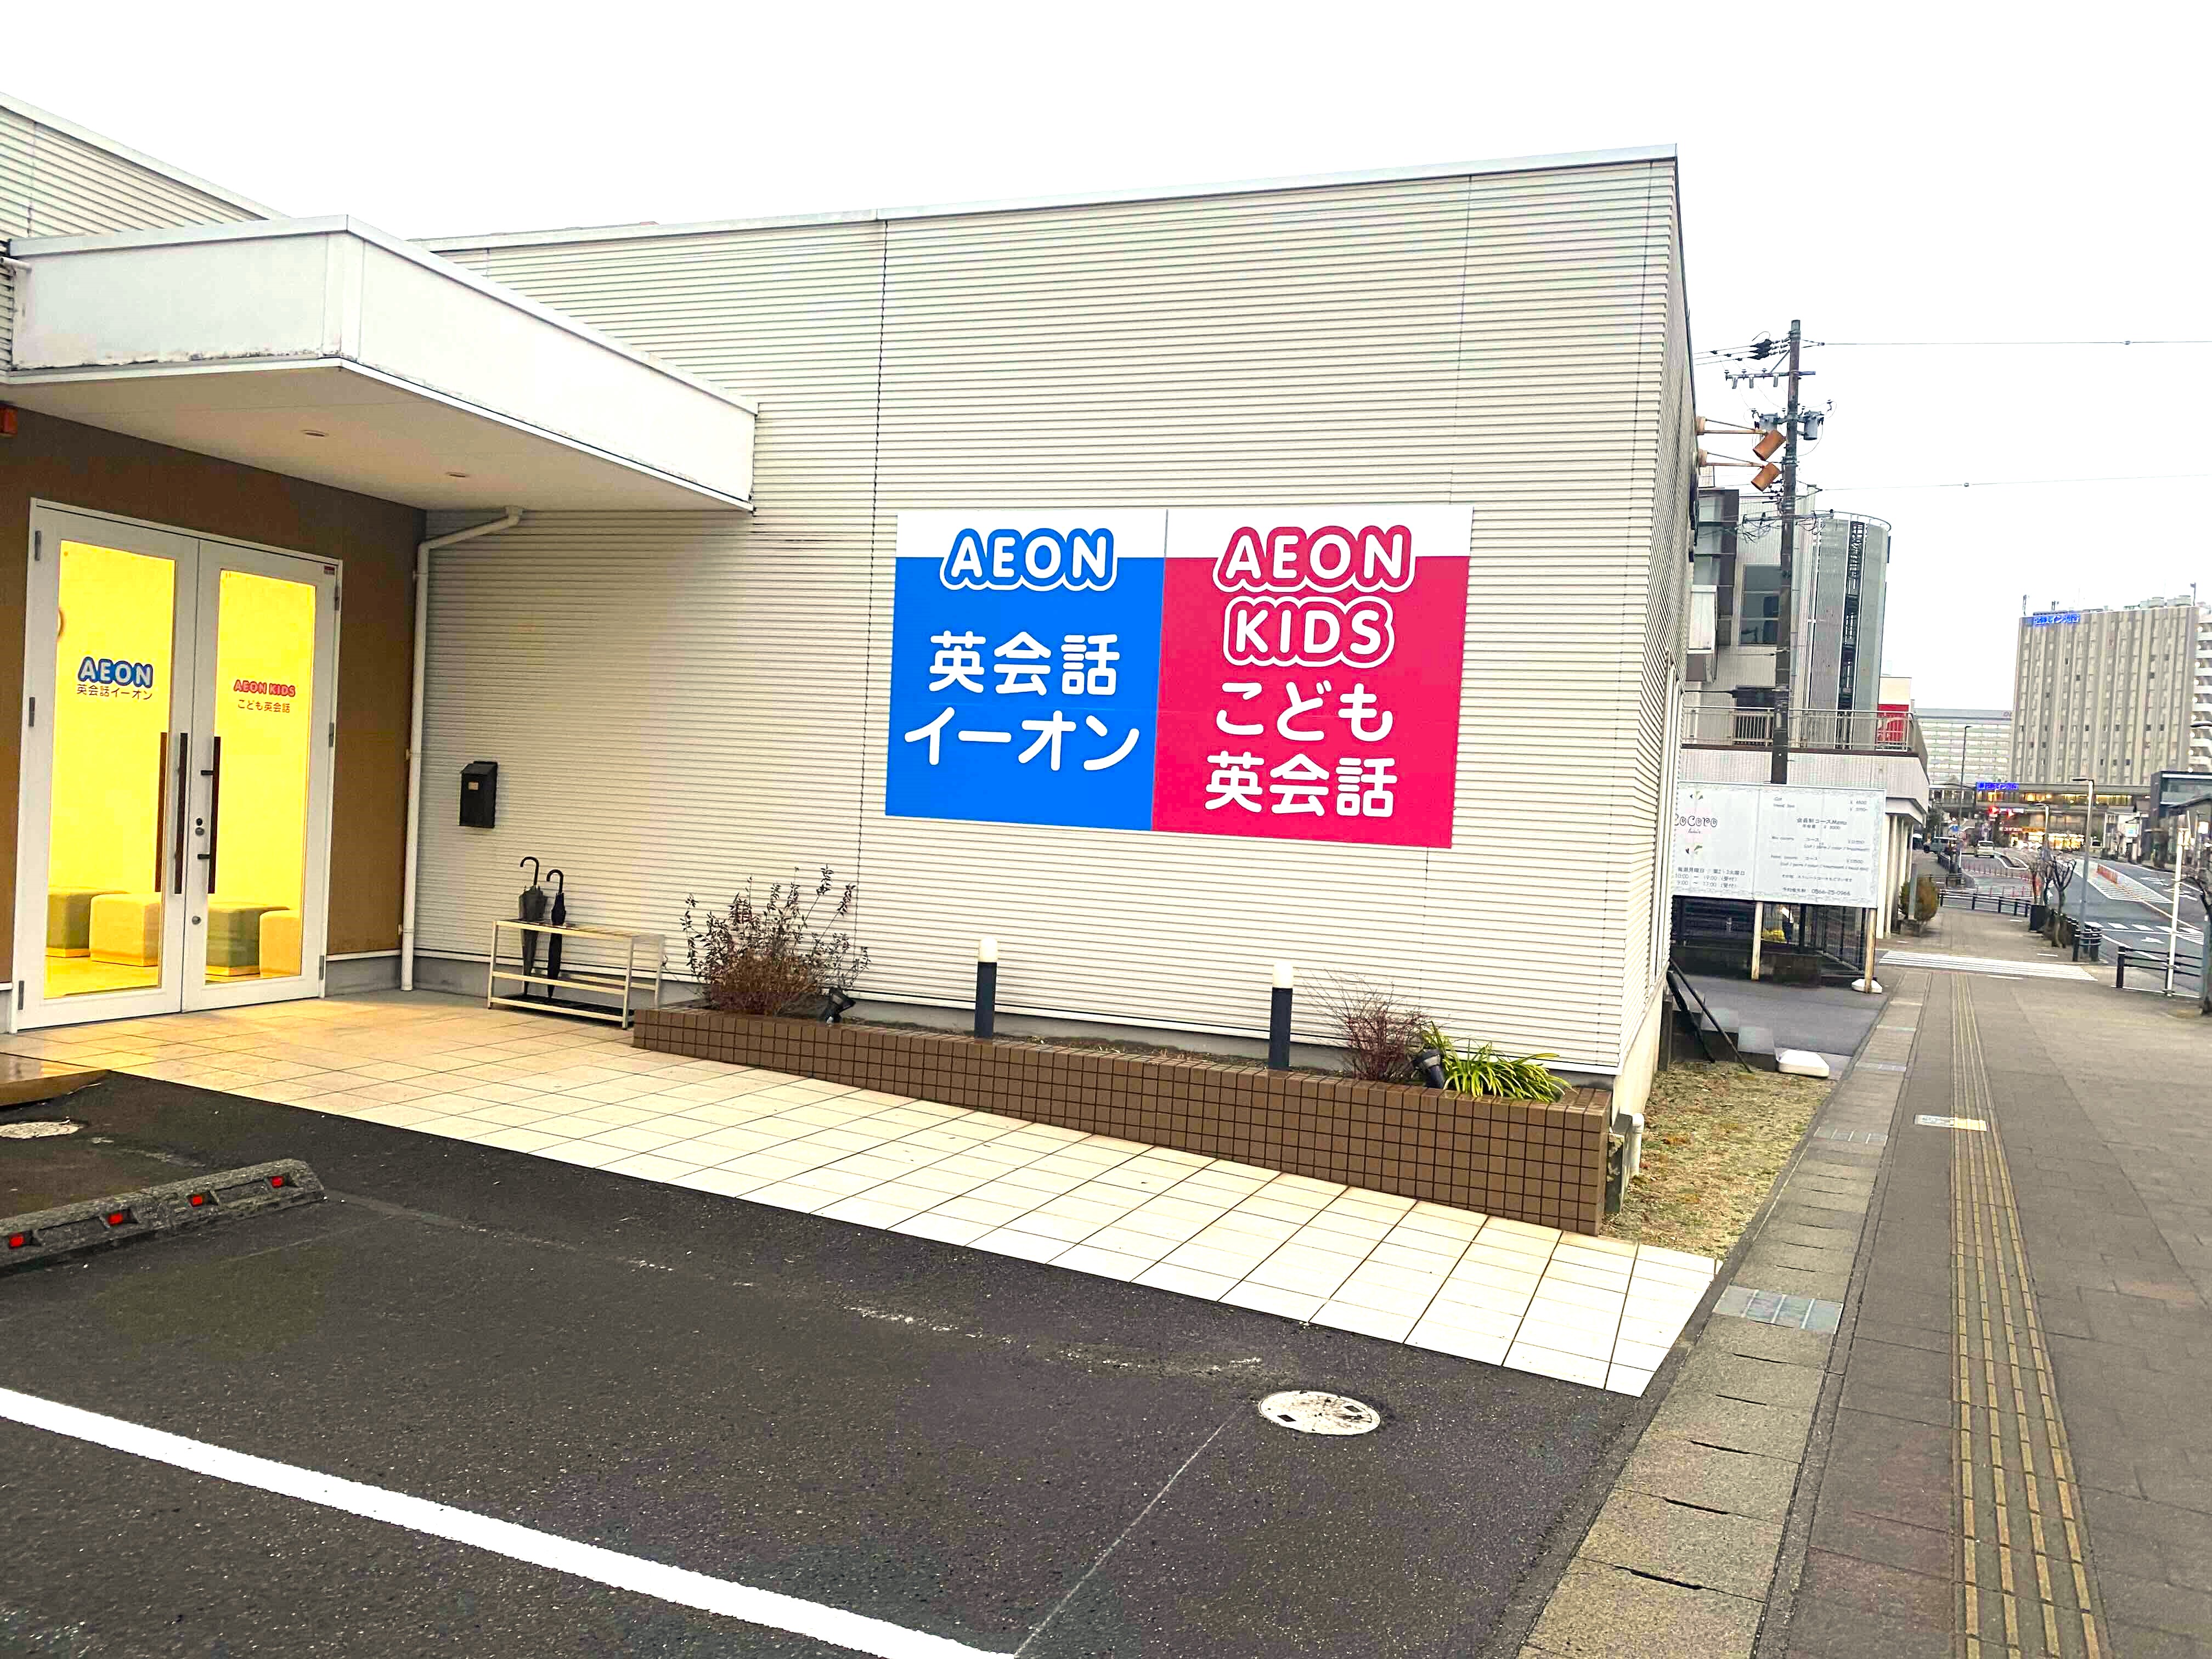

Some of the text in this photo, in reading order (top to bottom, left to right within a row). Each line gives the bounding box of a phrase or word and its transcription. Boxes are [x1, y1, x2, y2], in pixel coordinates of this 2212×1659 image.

[946, 529, 1113, 586] AEON
[1220, 526, 1410, 588] AEON
[1229, 602, 1389, 662] KIDS
[77, 684, 153, 700] 英会話イーオン
[78, 657, 153, 688] AEON
[234, 679, 296, 697] AEON KIDS
[929, 630, 1120, 696] 英会話
[238, 699, 290, 713] こども英会話
[1216, 680, 1393, 742] こども
[905, 706, 1139, 771] イーオン
[1205, 751, 1397, 817] 英会話
